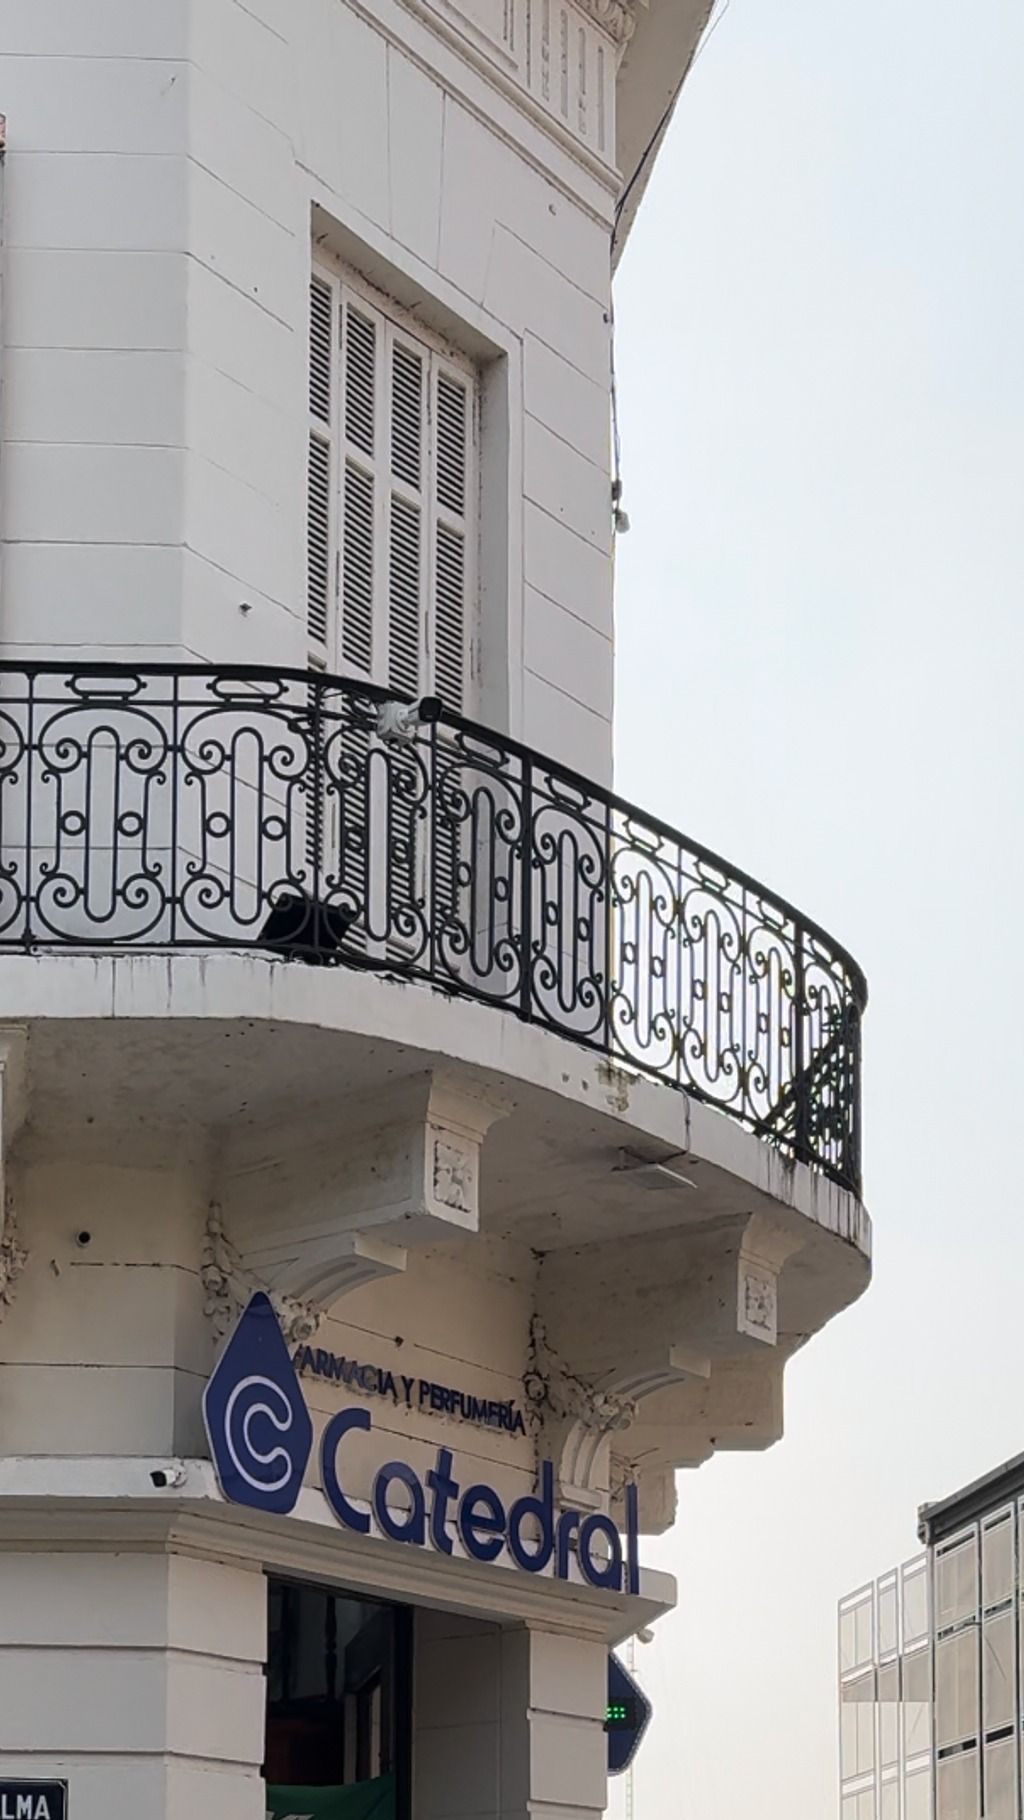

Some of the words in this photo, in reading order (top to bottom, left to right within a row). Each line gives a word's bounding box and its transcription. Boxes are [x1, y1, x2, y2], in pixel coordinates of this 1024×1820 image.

[400, 1376, 414, 1408] Y
[419, 1380, 527, 1436] PERFUMERÍA
[321, 1407, 640, 1596] Catedral
